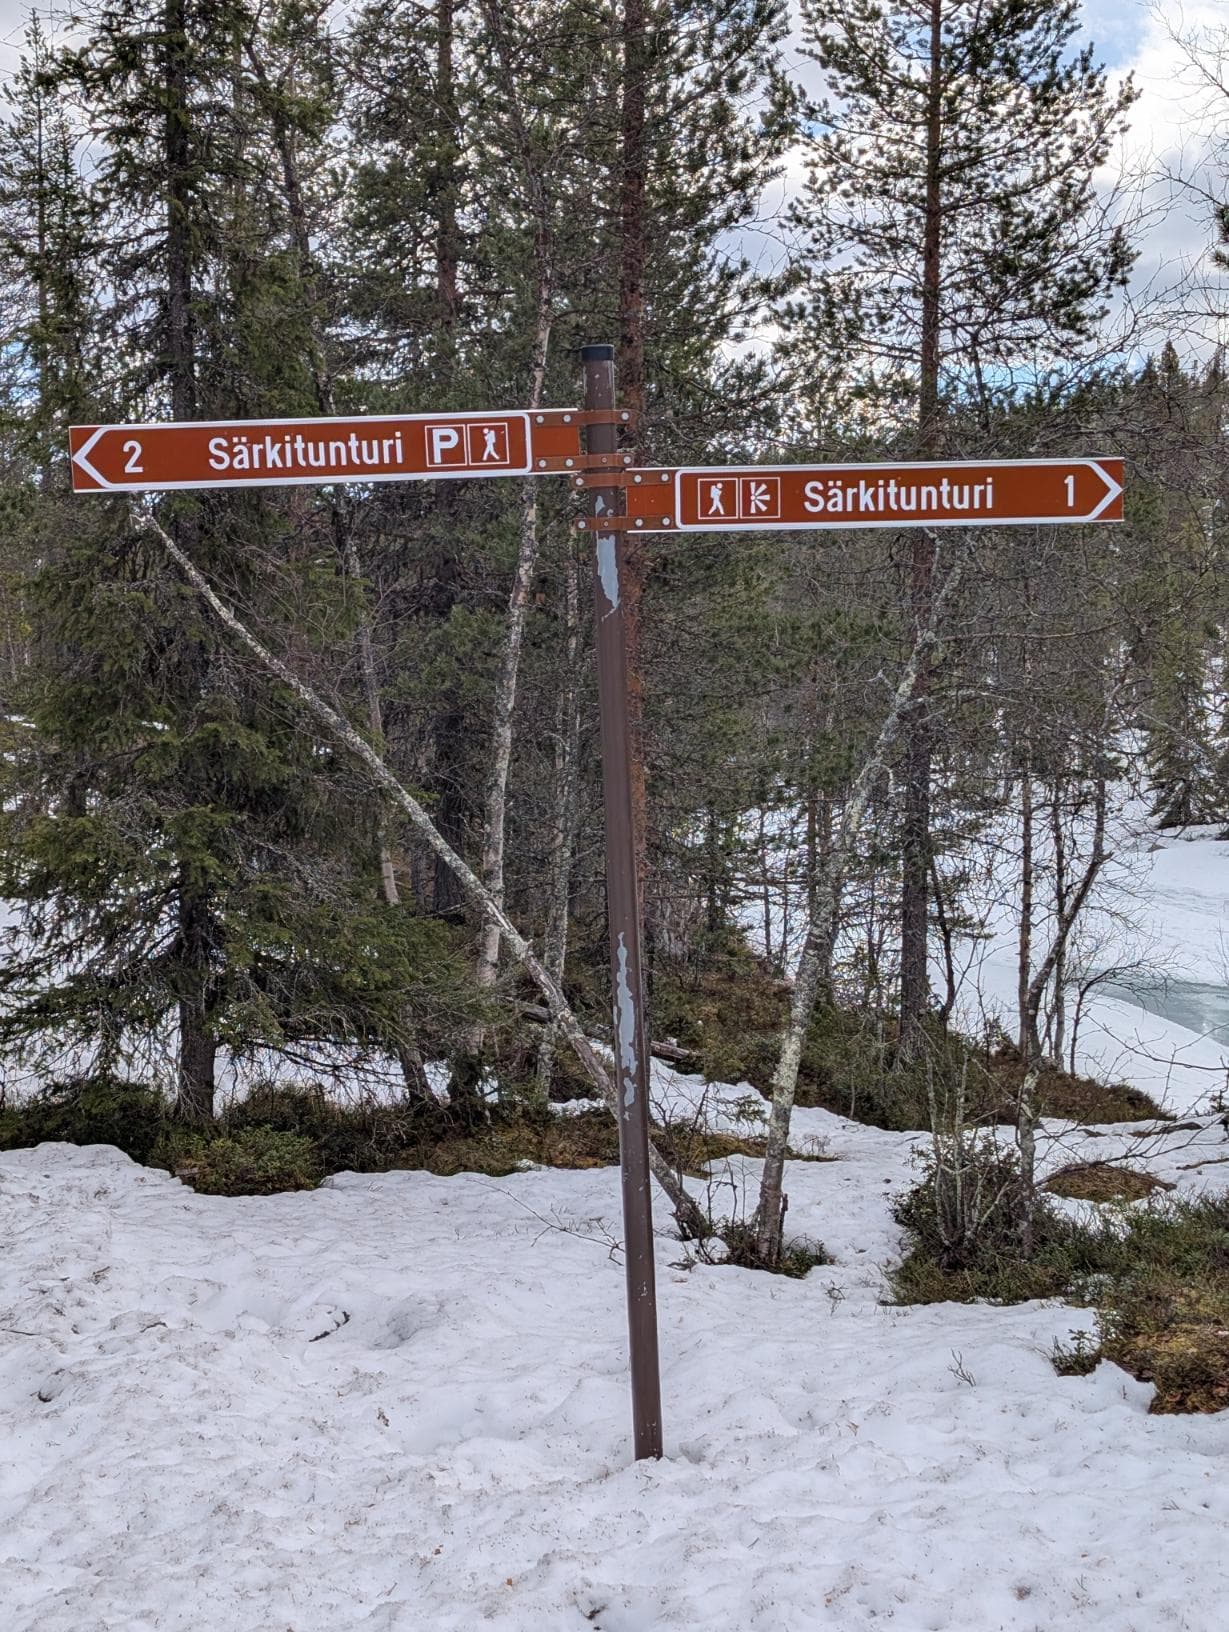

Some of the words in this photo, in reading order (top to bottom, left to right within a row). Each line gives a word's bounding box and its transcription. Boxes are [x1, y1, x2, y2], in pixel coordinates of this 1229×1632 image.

[122, 440, 144, 474] 2
[208, 431, 403, 470] Särkitunturi
[432, 427, 459, 464] P
[804, 476, 994, 513] Särkitunturi
[1064, 475, 1074, 507] 1
